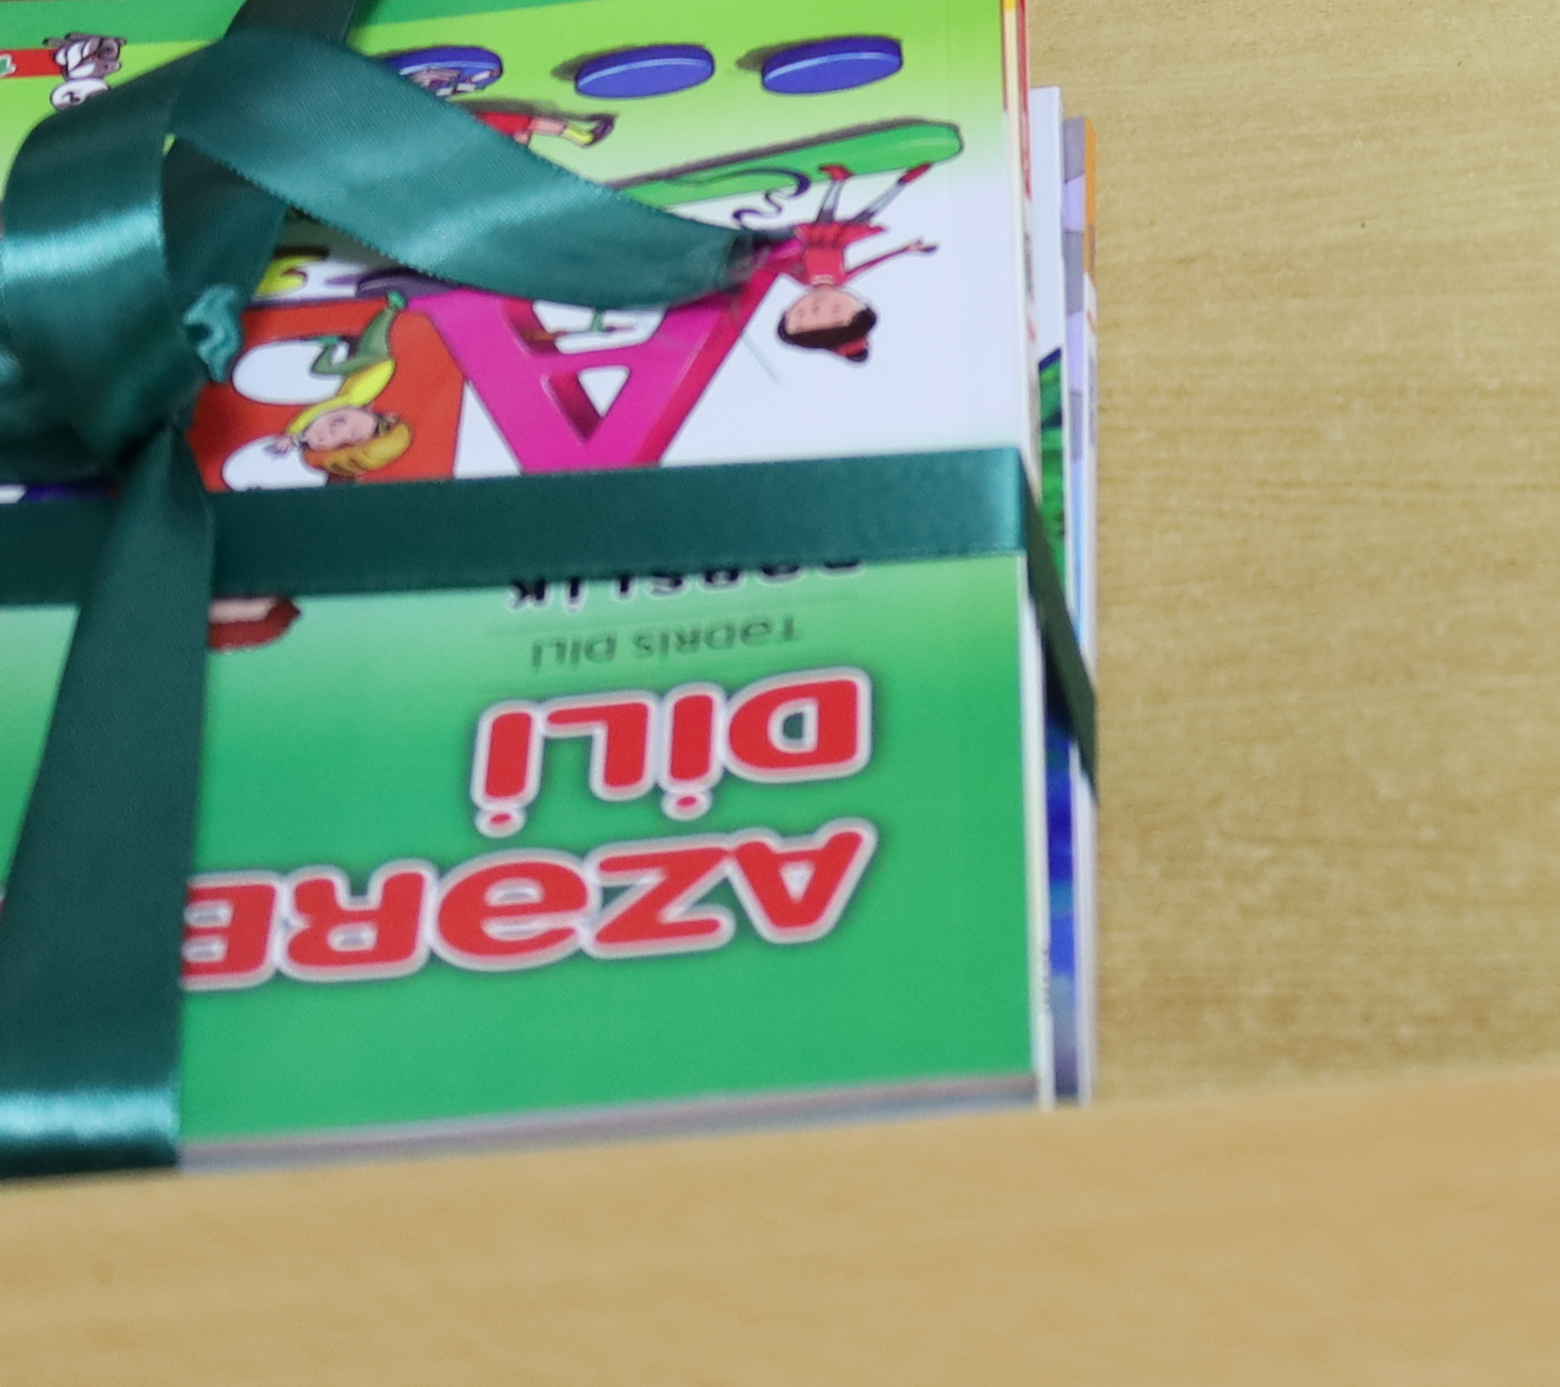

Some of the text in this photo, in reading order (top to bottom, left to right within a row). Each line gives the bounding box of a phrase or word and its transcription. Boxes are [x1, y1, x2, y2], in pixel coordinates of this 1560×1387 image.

[531, 613, 796, 673] TƏDRİS DİLİ
[471, 667, 872, 838] DİLİ
